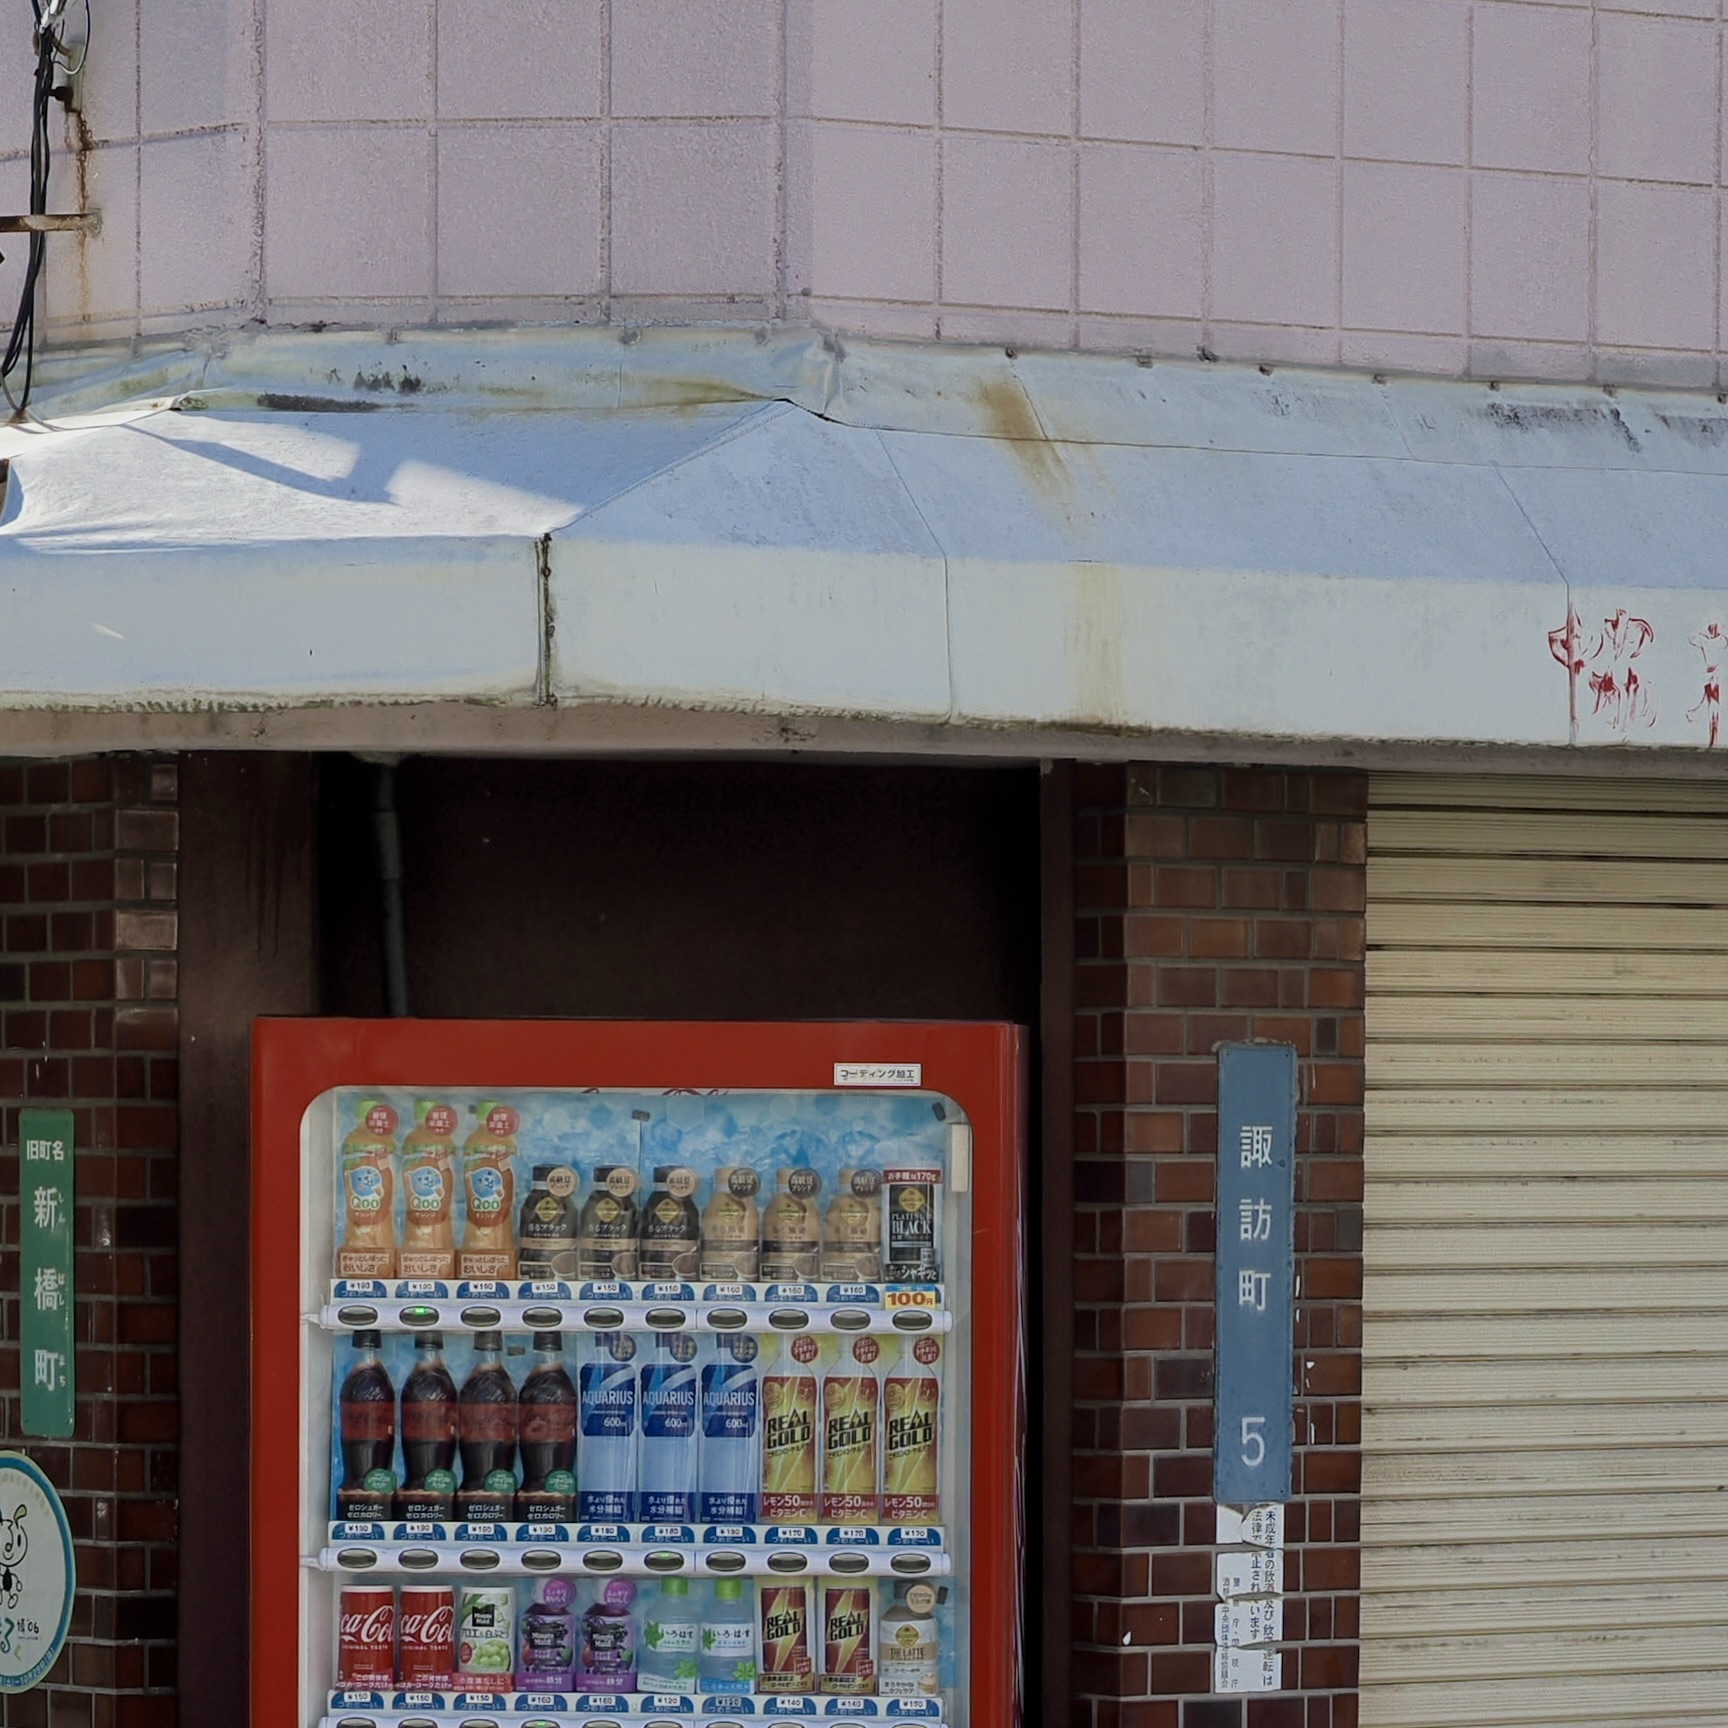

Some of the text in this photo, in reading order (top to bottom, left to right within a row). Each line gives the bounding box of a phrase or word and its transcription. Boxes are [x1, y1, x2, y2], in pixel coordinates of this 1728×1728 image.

[26, 1139, 64, 1161] 旧町名
[351, 1198, 379, 1210] Qoo
[412, 1198, 440, 1210] Qoo
[473, 1199, 500, 1210] Qoo
[891, 1221, 932, 1234] BLACK
[343, 1263, 375, 1273] おいしさ
[403, 1264, 437, 1273] おいしさ
[463, 1264, 496, 1274] おいしさ
[34, 1186, 59, 1391] 新橋町
[1238, 1124, 1273, 1468] 諏訪町 5
[887, 1293, 934, 1306] 100円
[582, 1390, 634, 1406] AQUARIUS
[643, 1391, 695, 1406] AQUARIUS
[703, 1391, 755, 1407] AQUARIUS
[767, 1408, 809, 1434] REAL
[828, 1408, 870, 1434] REAL
[889, 1409, 932, 1436] REAL
[767, 1425, 811, 1450] GOLD
[828, 1426, 872, 1450] GOLD
[889, 1426, 932, 1451] GOLD
[348, 1503, 384, 1511] ゼロシュガー
[529, 1504, 566, 1512] ゼロシュガー
[770, 1508, 807, 1518] ビタミンC
[831, 1509, 867, 1519] ビタミンC
[891, 1510, 928, 1519] ビタミンC
[766, 1609, 800, 1631] REAL
[830, 1610, 864, 1632] REAL
[767, 1621, 801, 1641] GOLD
[830, 1622, 864, 1642] GOLD
